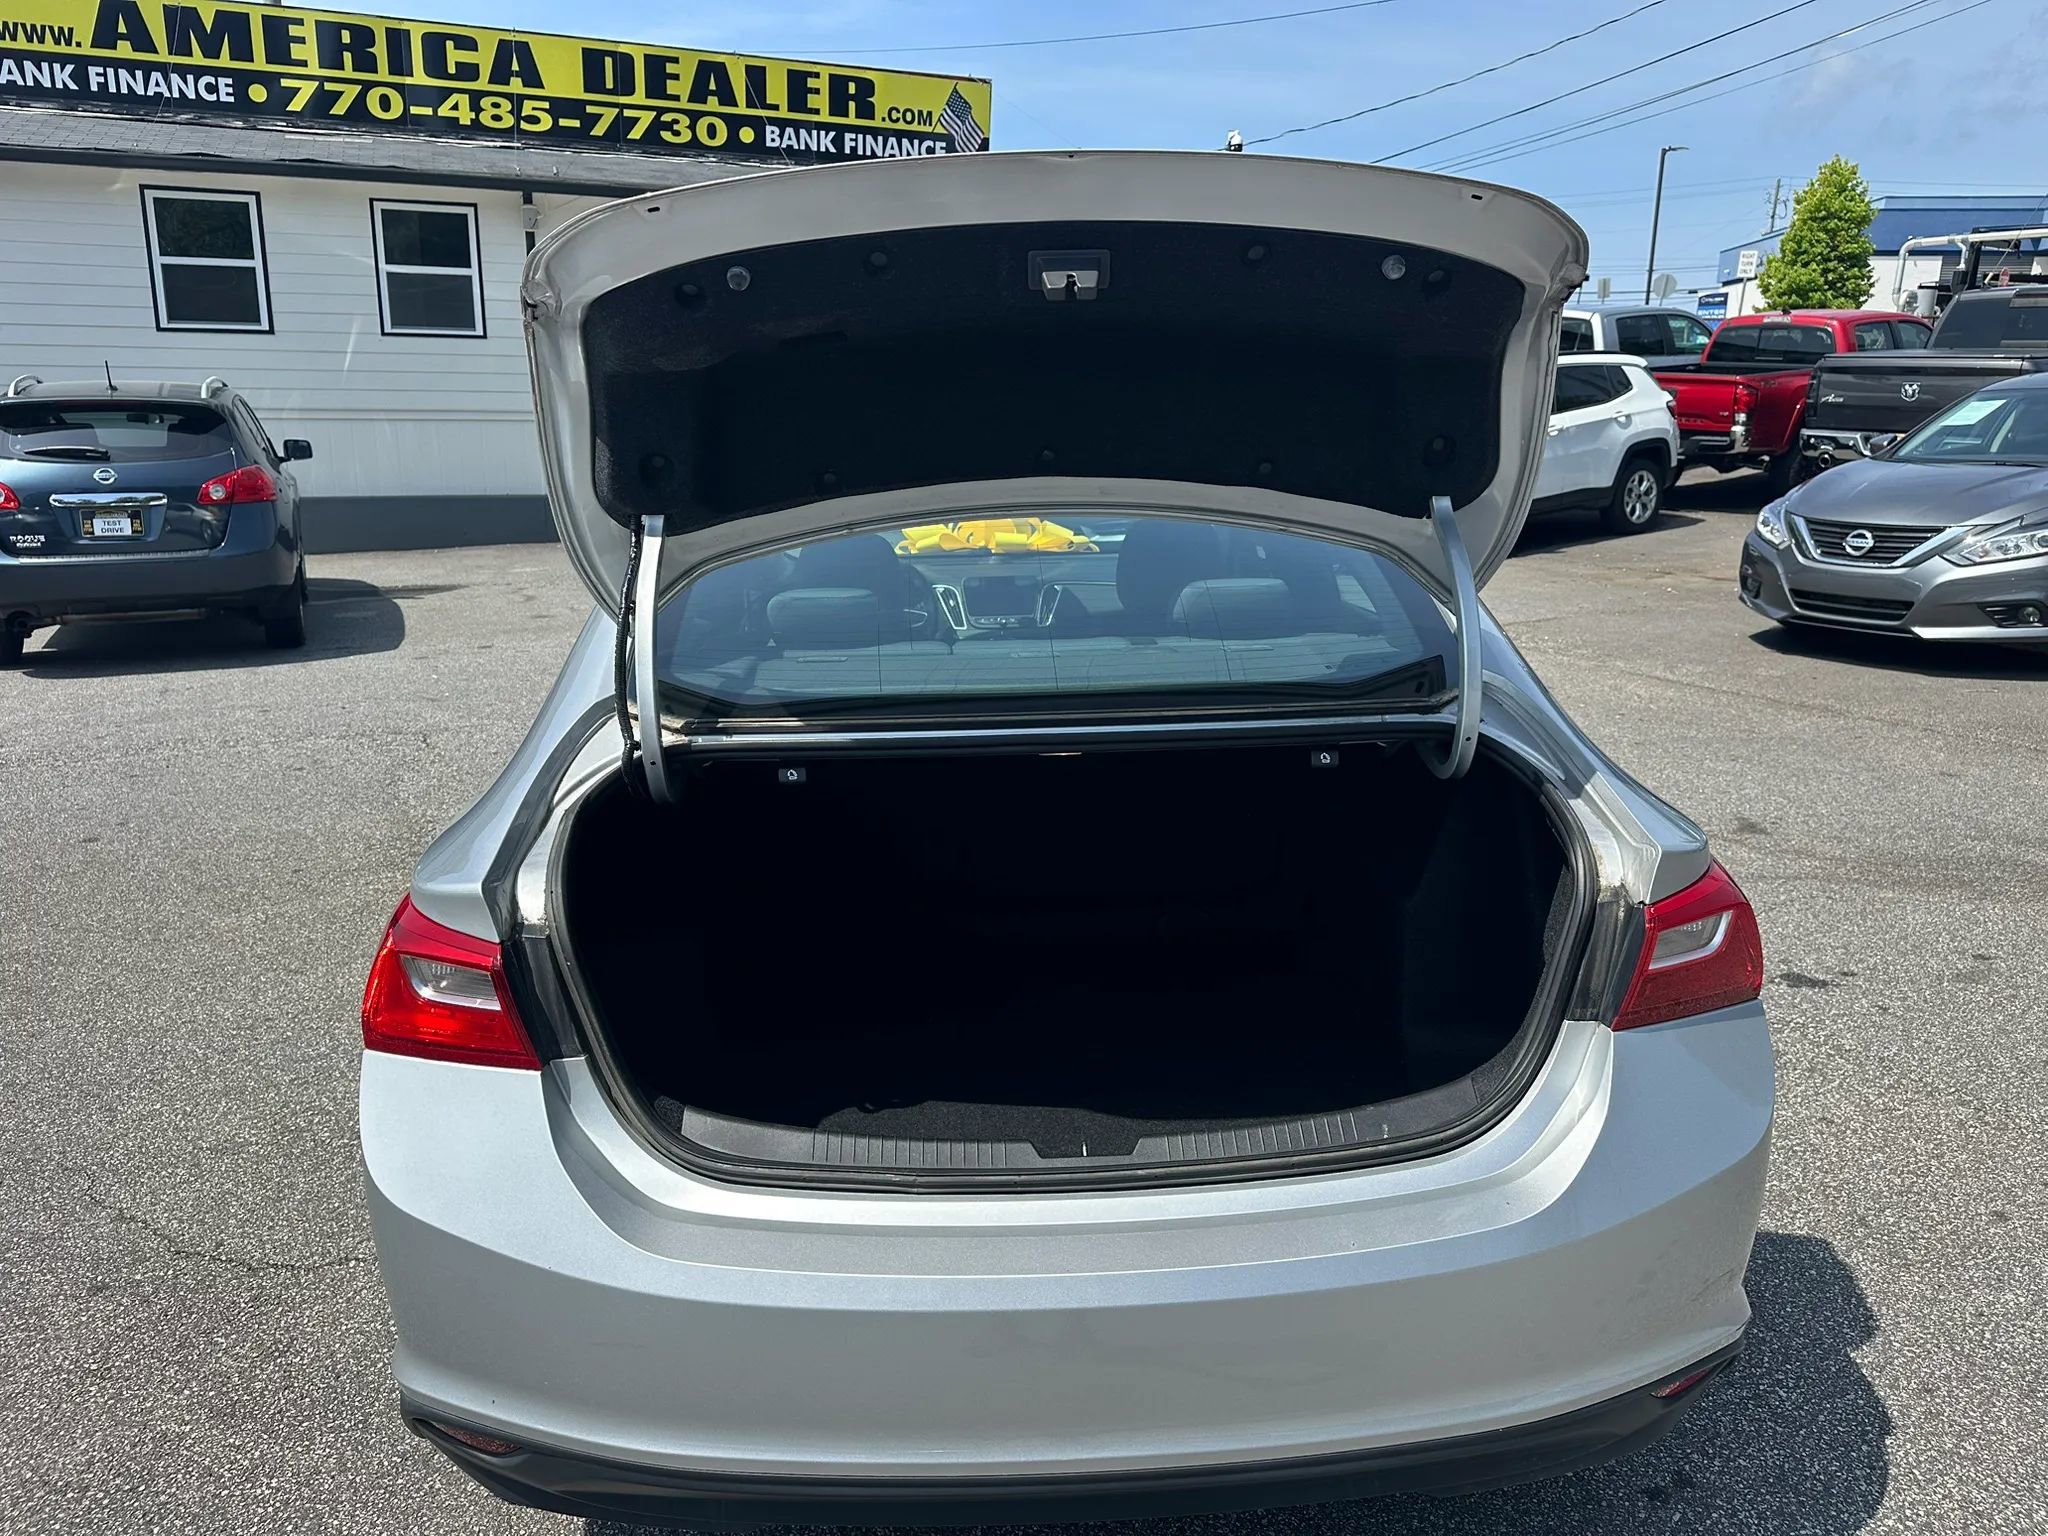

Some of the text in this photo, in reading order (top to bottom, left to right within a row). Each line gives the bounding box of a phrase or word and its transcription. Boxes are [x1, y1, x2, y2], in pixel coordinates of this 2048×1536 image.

[88, 65, 235, 102] FINANCE
[280, 78, 728, 147] 770-485-7730
[765, 125, 837, 153] BANK
[90, 0, 545, 89] AMERICA
[581, 47, 876, 120] DEALER
